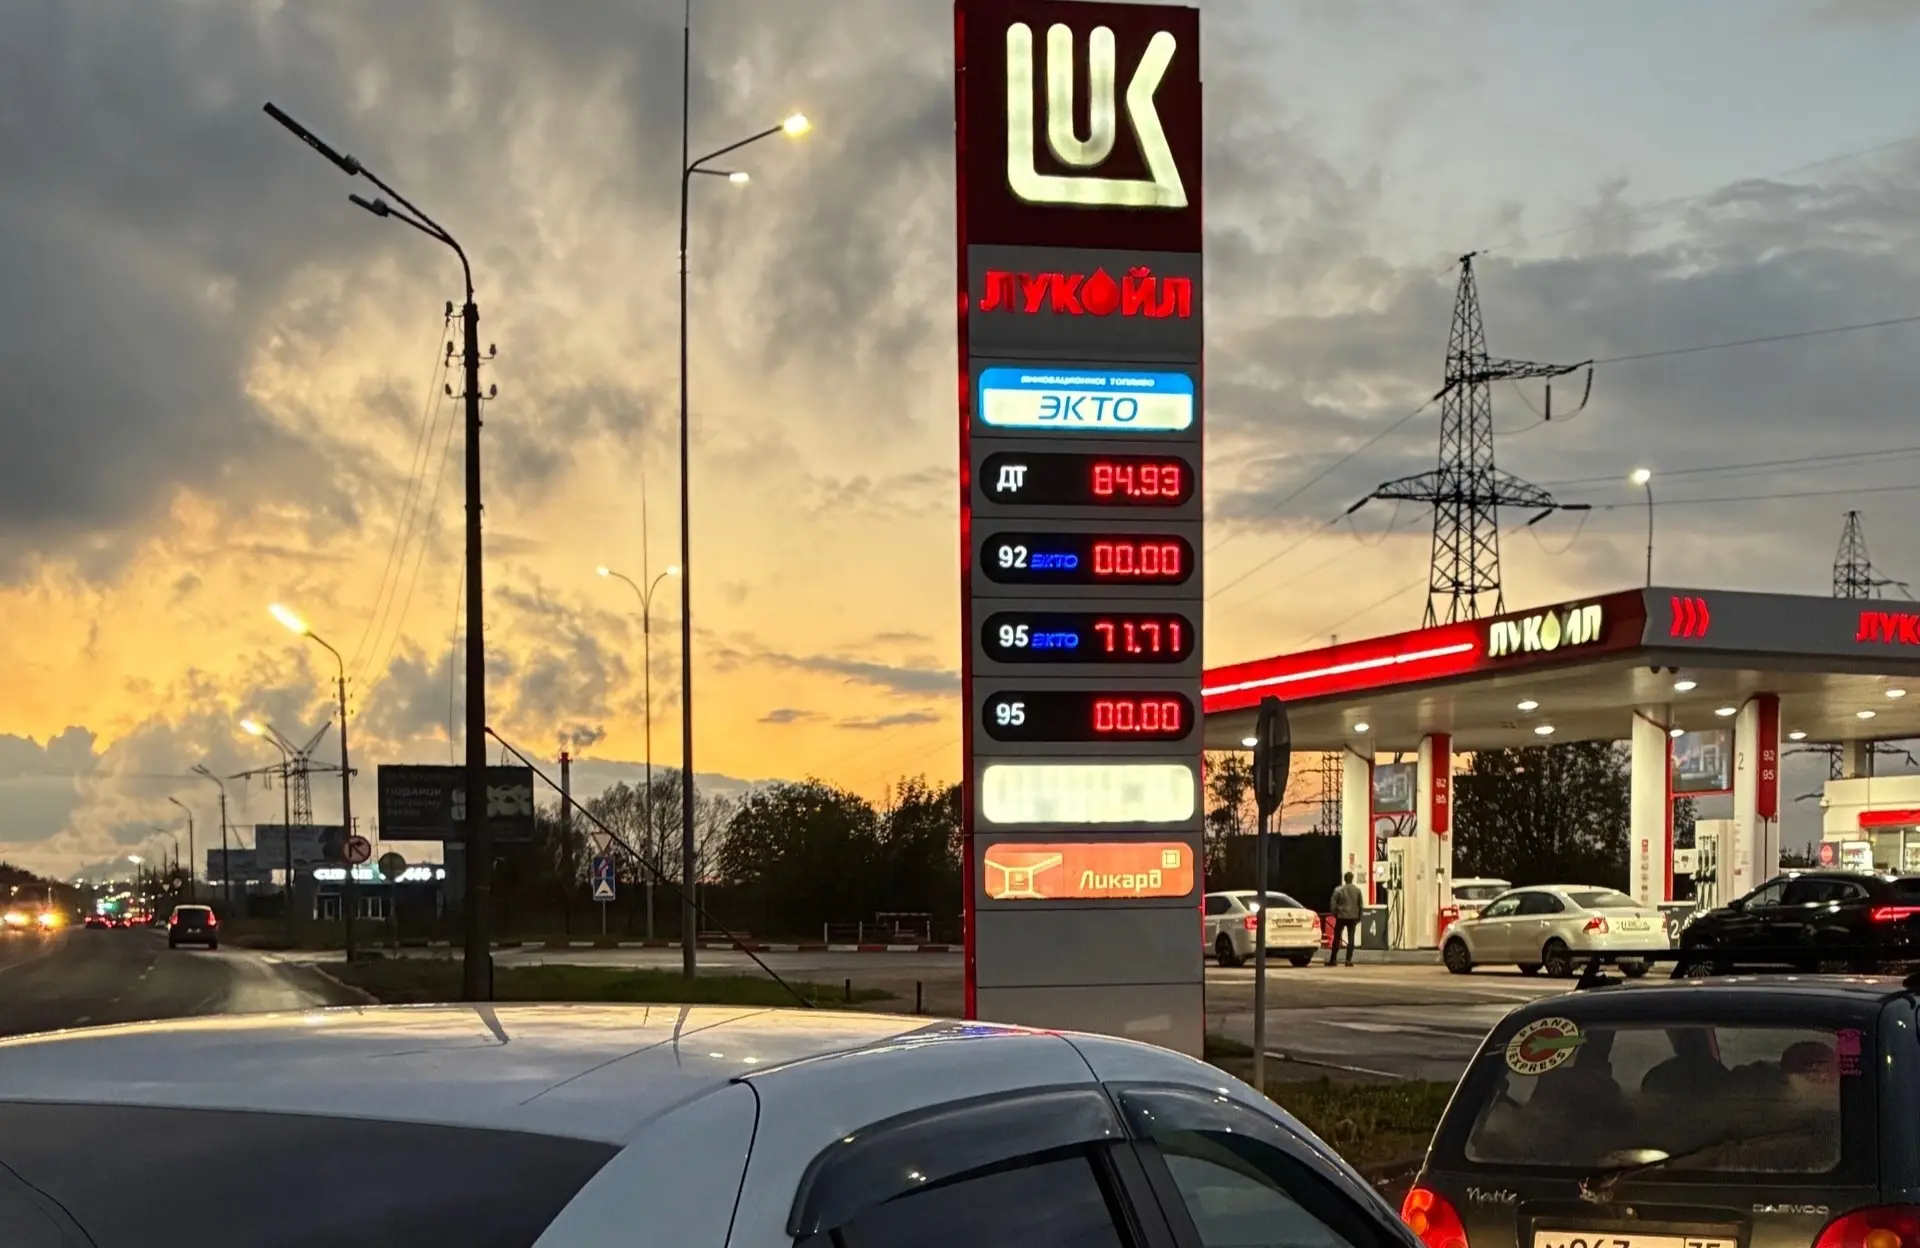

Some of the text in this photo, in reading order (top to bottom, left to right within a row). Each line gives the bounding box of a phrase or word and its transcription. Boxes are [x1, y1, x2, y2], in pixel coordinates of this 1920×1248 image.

[980, 266, 1192, 318] ЛУКОЙЛ
[1038, 395, 1139, 422] ЭКТО
[996, 464, 1181, 496] ДТ 84.93
[998, 545, 1181, 575] 92 ЭКТО 00.00
[998, 623, 1181, 653] 95 ЭКТО 71.71
[1855, 611, 1920, 646] ЛУК
[995, 702, 1181, 731] 95 00.00
[1763, 769, 1775, 780] 95
[1079, 869, 1162, 893] Ликард
[1369, 920, 1377, 937] 4
[1670, 919, 1680, 940] 2
[1519, 1019, 1575, 1038] PLANET
[1509, 1051, 1566, 1072] EXPRESS
[1752, 1203, 1829, 1215] DAEWOO
